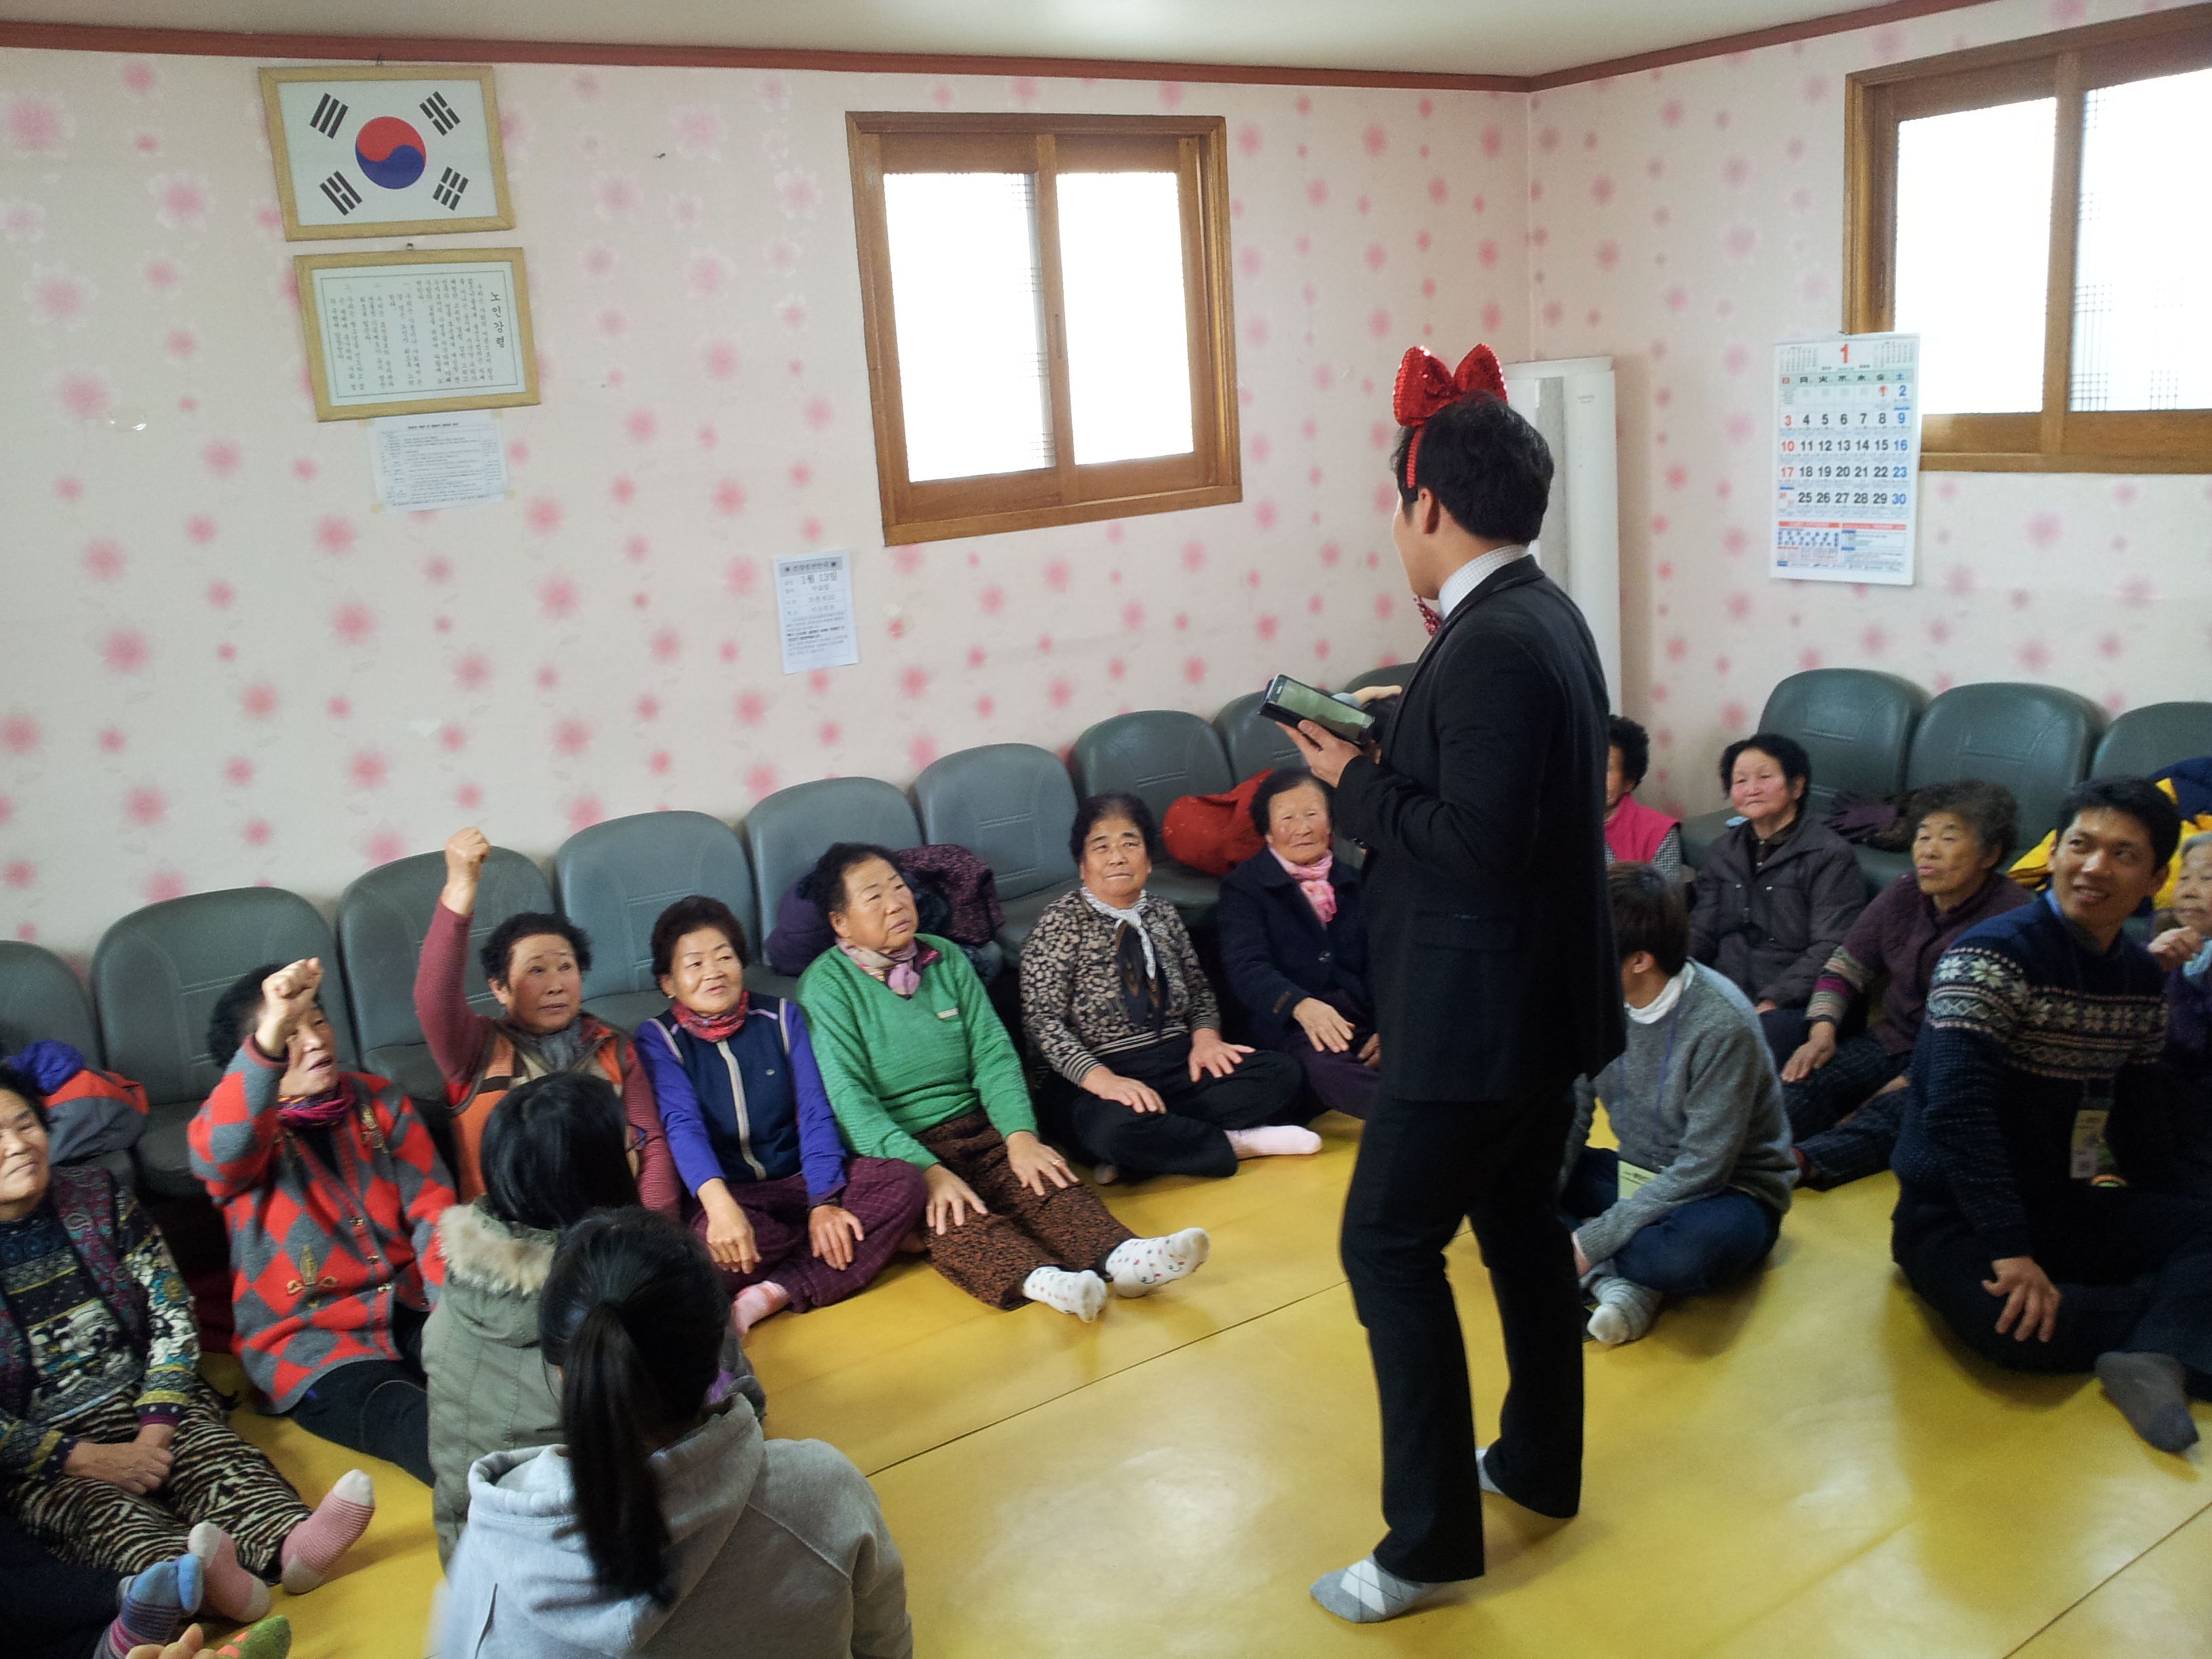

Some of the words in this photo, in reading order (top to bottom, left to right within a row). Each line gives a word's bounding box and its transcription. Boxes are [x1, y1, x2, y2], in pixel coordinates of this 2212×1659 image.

[490, 292, 505, 348] 노인강령
[1841, 344, 1849, 364] 1
[1879, 385, 1887, 396] 1
[1899, 385, 1906, 396] 2
[1785, 415, 1792, 426] 3
[1803, 415, 1809, 425] 4
[1822, 413, 1828, 425] 5
[1840, 414, 1847, 425] 6
[1860, 413, 1867, 424] 7
[1879, 413, 1886, 424] 8
[1898, 413, 1905, 424] 9
[1782, 441, 1795, 451] 10
[1801, 441, 1813, 451] 11
[1819, 440, 1832, 451] 12
[1837, 440, 1850, 451] 13
[1856, 440, 1869, 451] 14
[1875, 440, 1889, 451] 15
[1894, 439, 1908, 451] 16
[1781, 466, 1795, 477] 17
[1799, 466, 1813, 477] 18
[1818, 466, 1831, 477] 19
[1836, 466, 1850, 477] 20
[1855, 466, 1868, 477] 21
[1874, 466, 1888, 477] 22
[1893, 466, 1907, 478] 23
[1798, 493, 1812, 503] 25
[1817, 493, 1830, 503] 26
[1835, 493, 1849, 503] 27
[1854, 493, 1868, 504] 28
[1872, 493, 1887, 504] 29
[1892, 493, 1906, 504] 30
[800, 574, 815, 584] 1월
[819, 571, 838, 581] 13일
